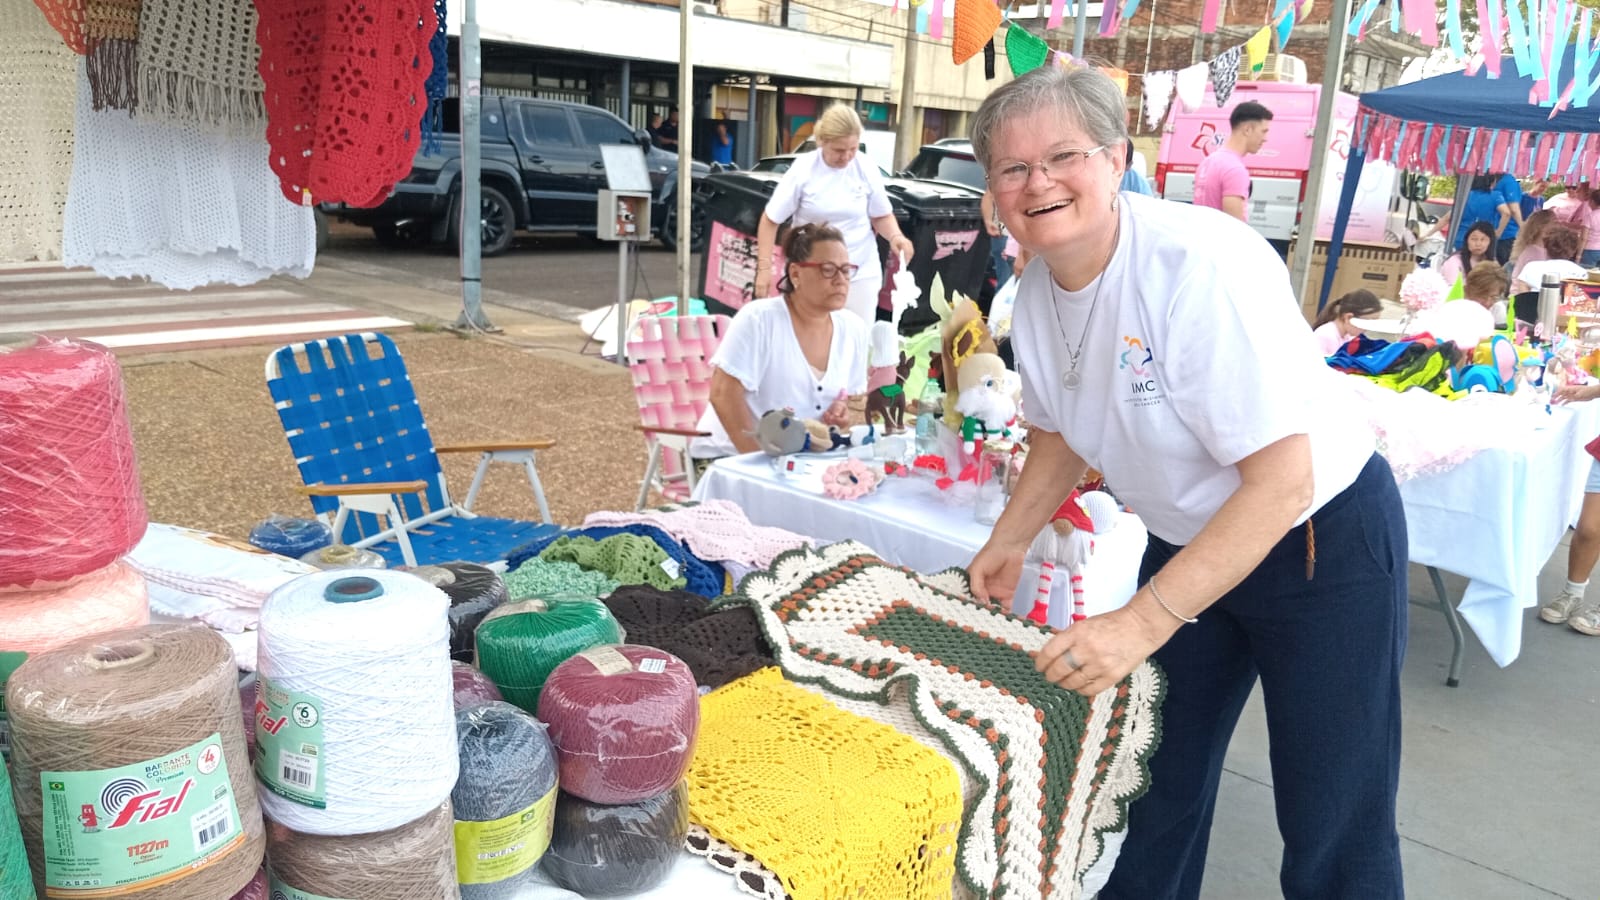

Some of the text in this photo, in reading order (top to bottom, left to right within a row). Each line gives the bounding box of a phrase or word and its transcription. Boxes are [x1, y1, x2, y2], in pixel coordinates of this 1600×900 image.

[1131, 380, 1156, 394] IMC
[300, 706, 310, 719] 6
[205, 749, 215, 763] 4
[107, 779, 192, 828] Fial
[127, 840, 169, 857] 1127m
